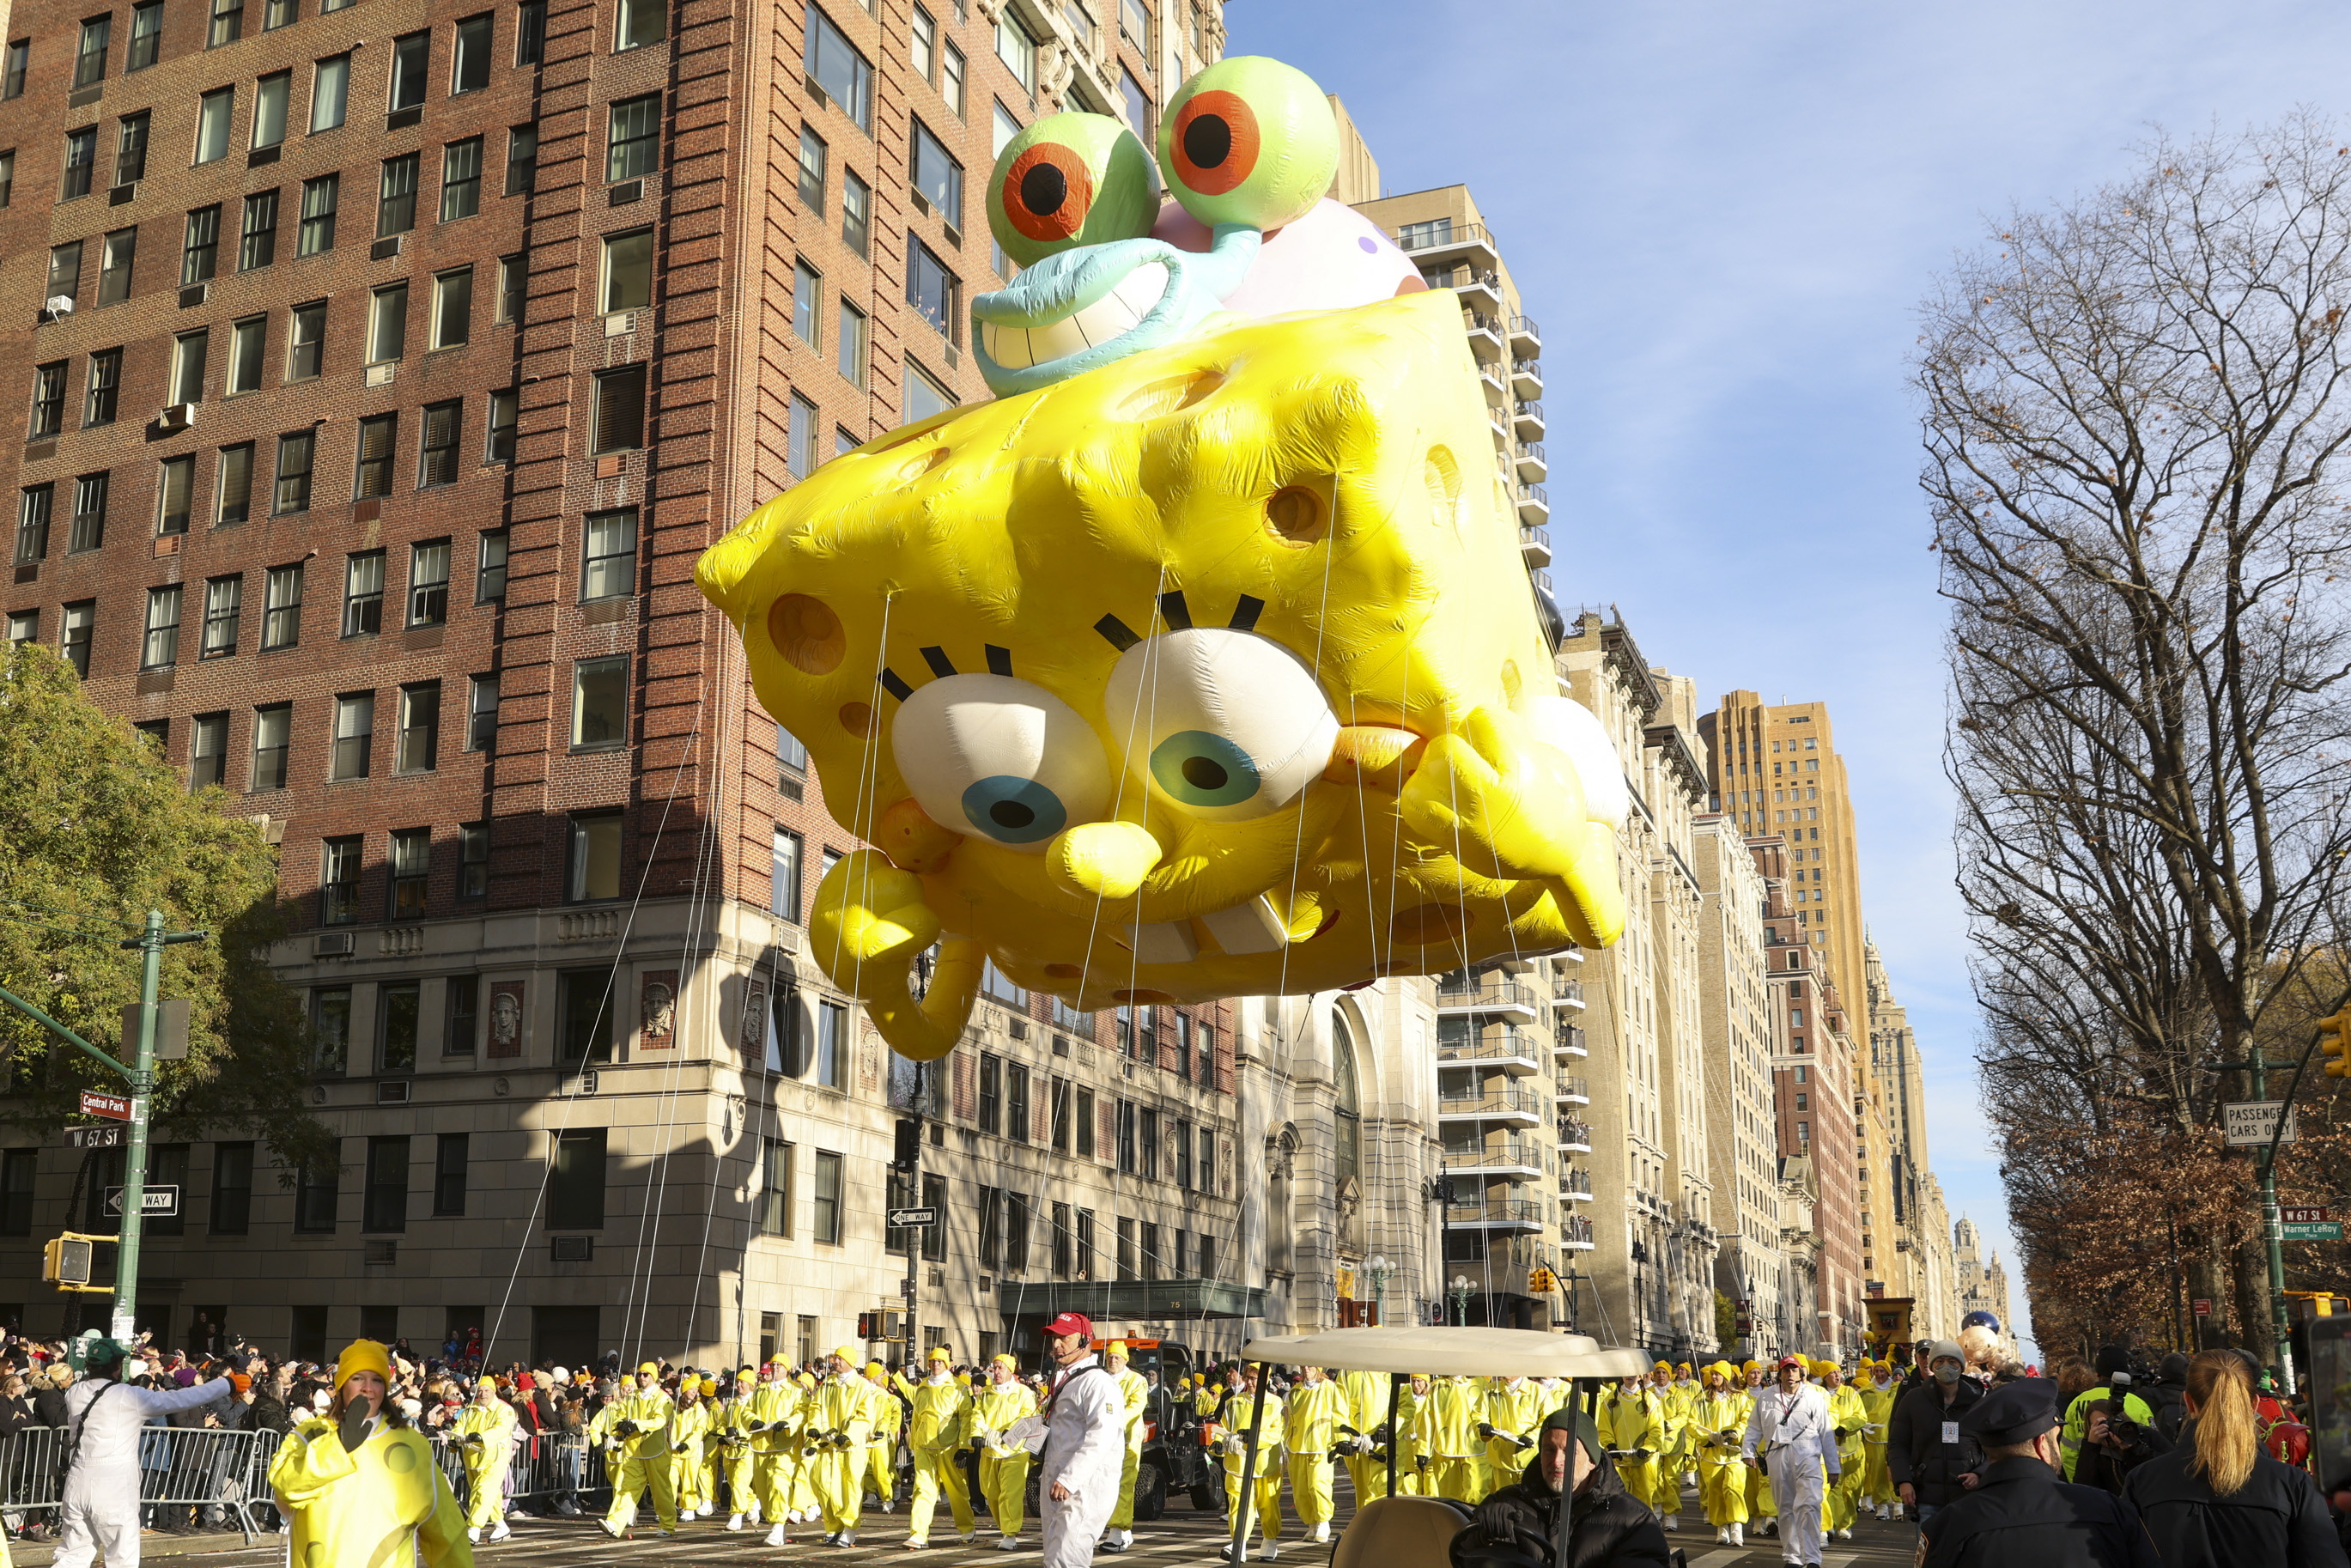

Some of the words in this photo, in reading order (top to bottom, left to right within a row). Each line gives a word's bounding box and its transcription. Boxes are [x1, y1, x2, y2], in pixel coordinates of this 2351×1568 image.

[83, 1095, 107, 1109] Central
[108, 1100, 125, 1112] Park
[2230, 1125, 2257, 1137] CARS
[74, 1131, 83, 1147] W
[87, 1129, 101, 1146] 67
[105, 1128, 119, 1145] ST
[145, 1194, 167, 1206] WAY
[2286, 1211, 2294, 1220] W
[2296, 1210, 2308, 1220] 67
[2311, 1210, 2321, 1220] St
[2284, 1225, 2311, 1233] Warner
[2312, 1224, 2337, 1234] LeRoy
